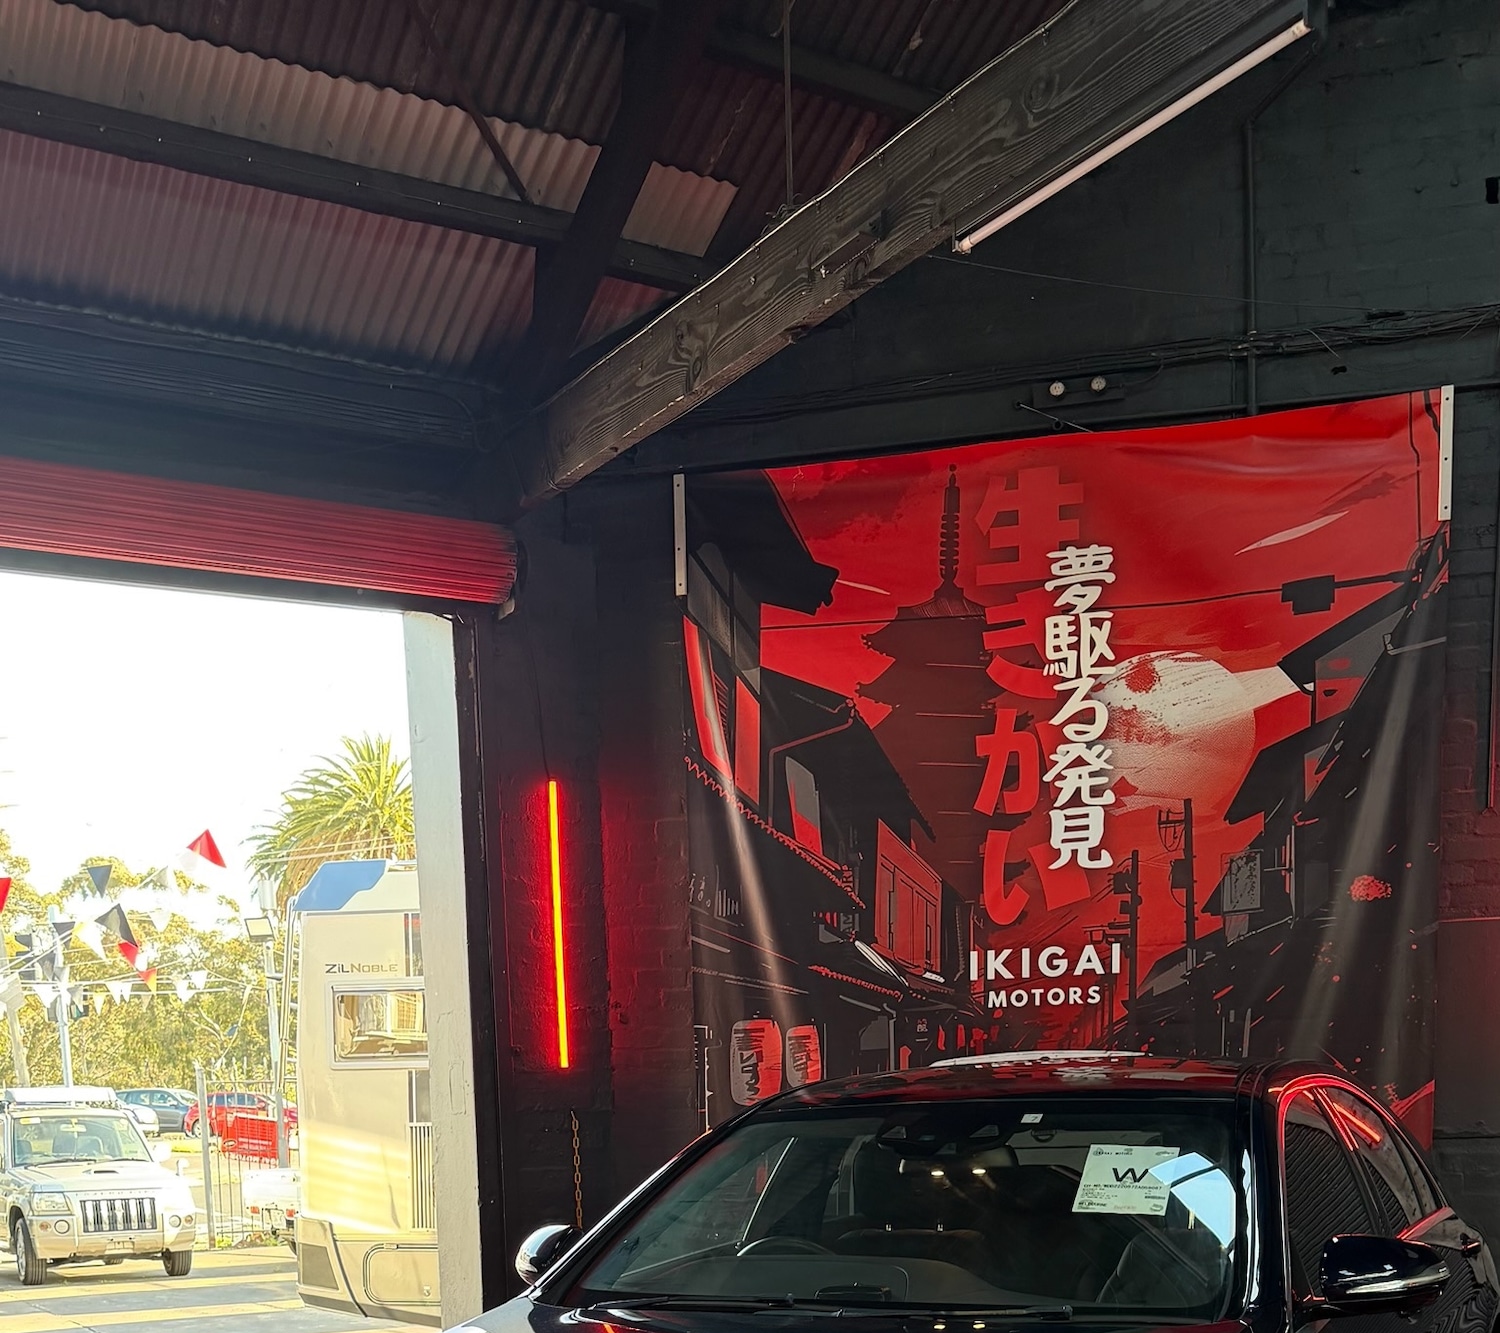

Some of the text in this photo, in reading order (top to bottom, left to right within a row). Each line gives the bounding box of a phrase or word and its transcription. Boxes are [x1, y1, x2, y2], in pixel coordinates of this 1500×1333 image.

[1042, 544, 1117, 870] 夢駆る発見
[969, 942, 1121, 981] IKIGAI
[987, 985, 1102, 1009] MOTORS
